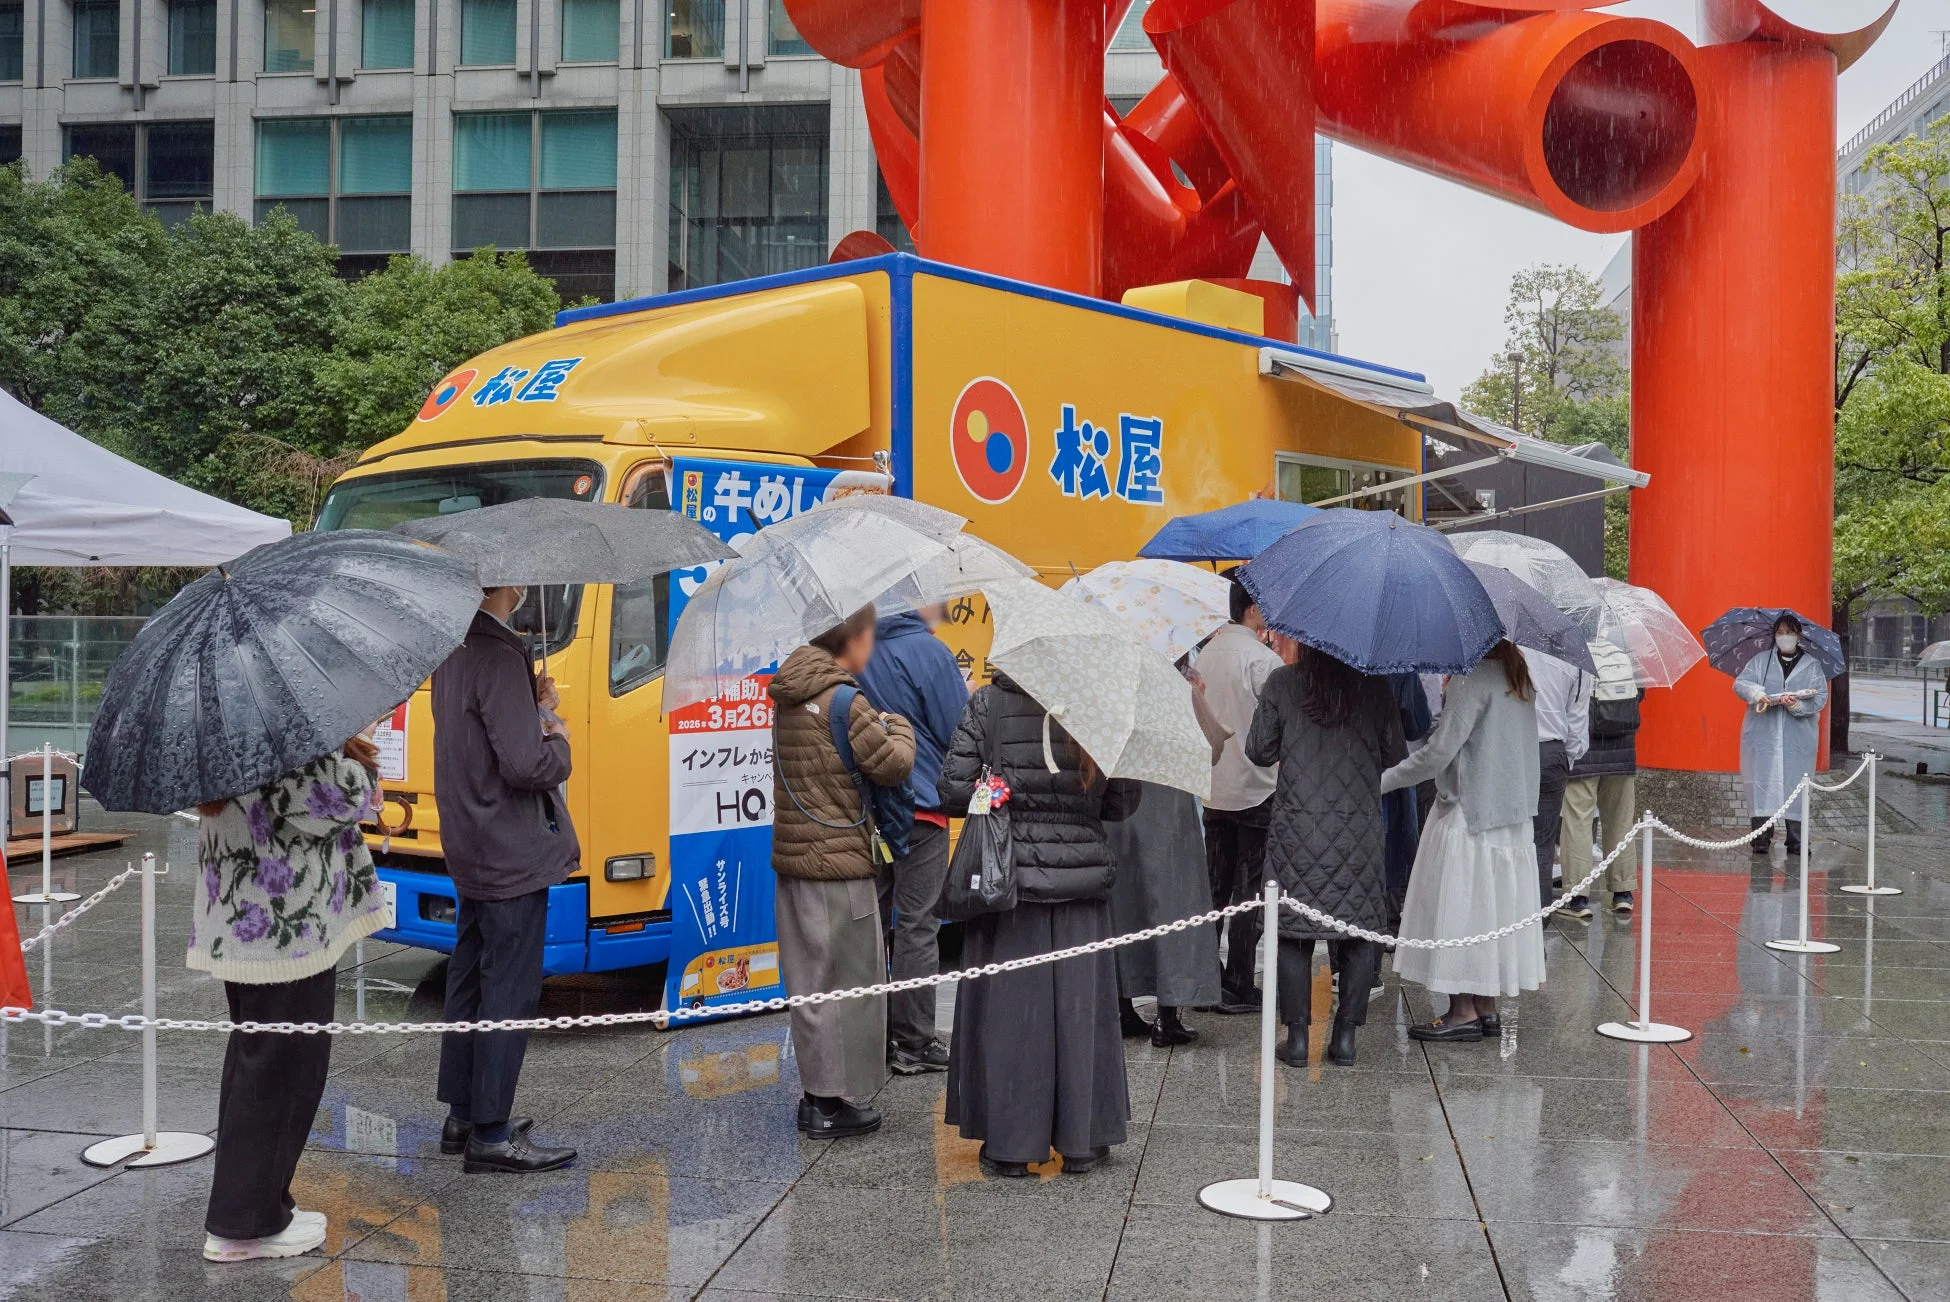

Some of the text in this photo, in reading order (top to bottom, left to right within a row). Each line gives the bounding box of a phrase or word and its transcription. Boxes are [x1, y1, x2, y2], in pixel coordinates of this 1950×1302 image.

[472, 357, 585, 409] 松屋
[1048, 402, 1165, 507] 松屋
[685, 487, 699, 520] 松屋
[716, 859, 730, 929] サンライズ号
